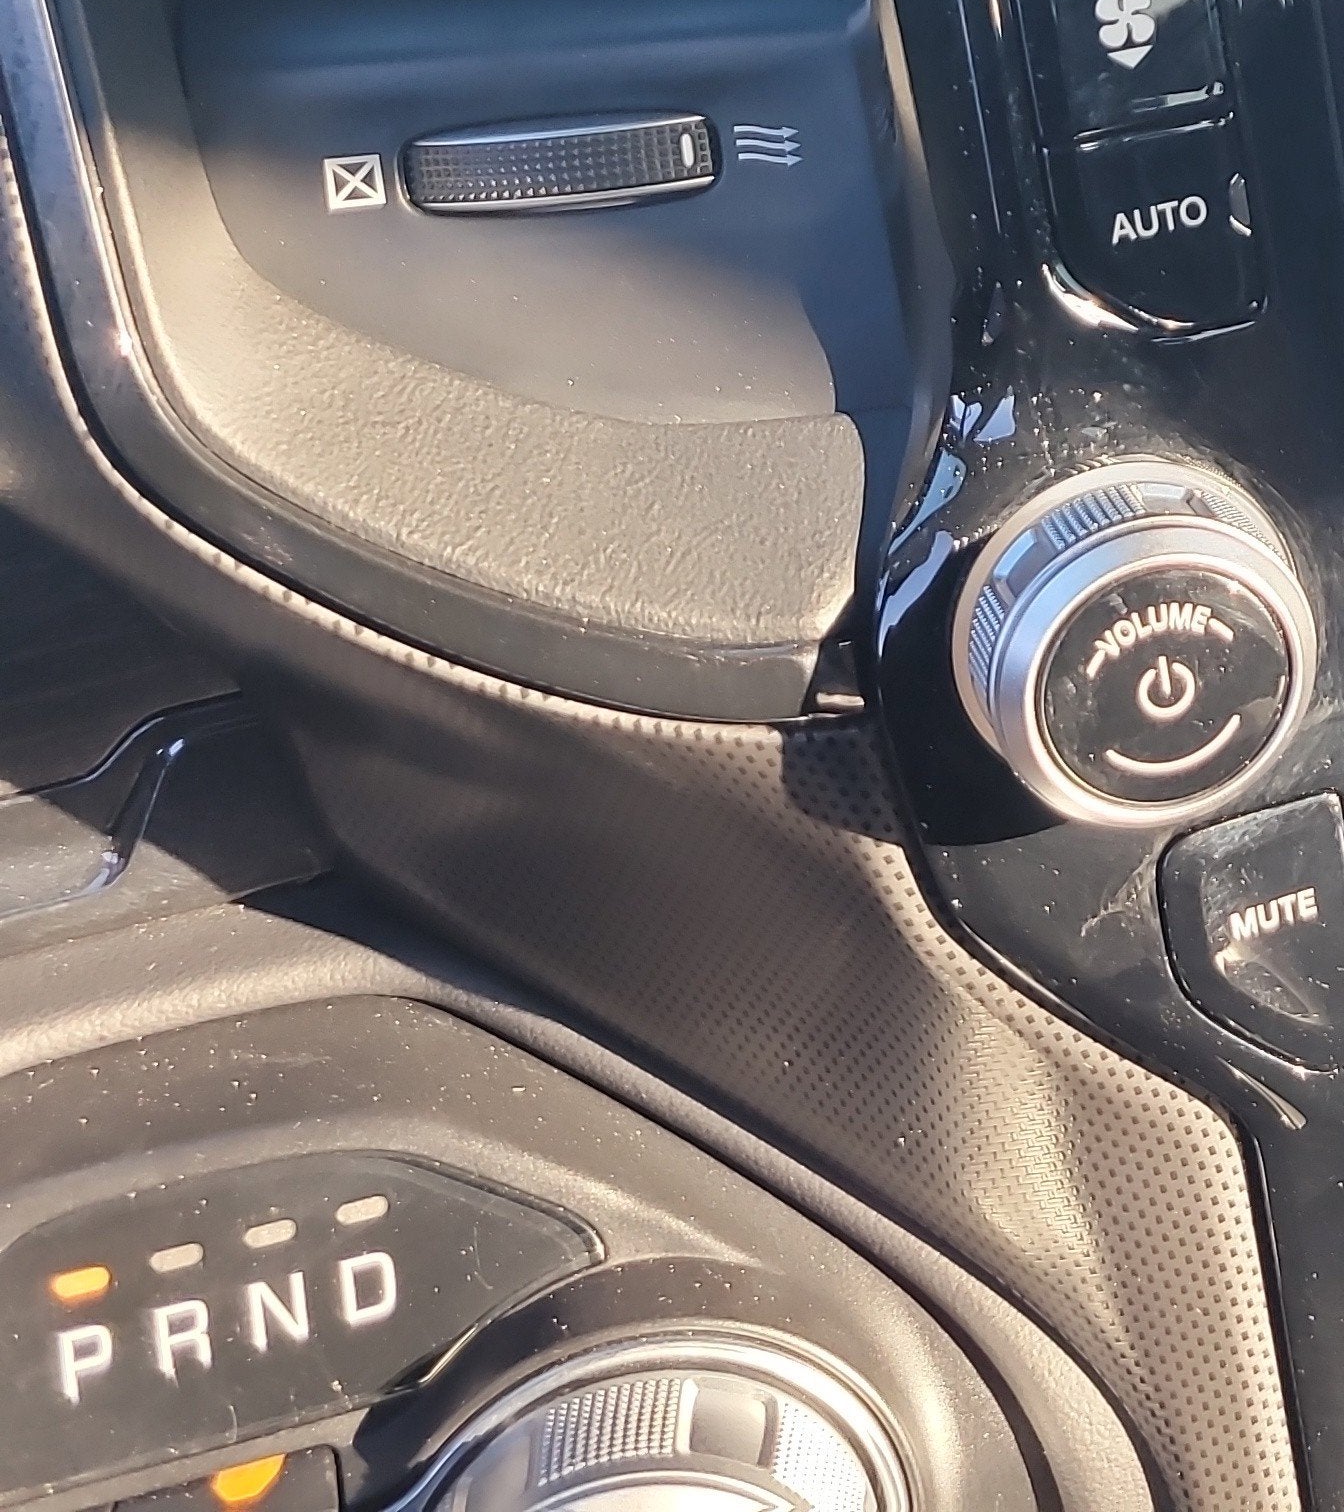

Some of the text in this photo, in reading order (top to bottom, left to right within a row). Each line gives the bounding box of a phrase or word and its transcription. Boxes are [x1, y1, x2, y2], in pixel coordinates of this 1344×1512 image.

[1110, 195, 1208, 245] AUTO
[1097, 602, 1211, 658] VOLUME
[1230, 888, 1318, 941] MUTE
[55, 1250, 398, 1406] P R N D
